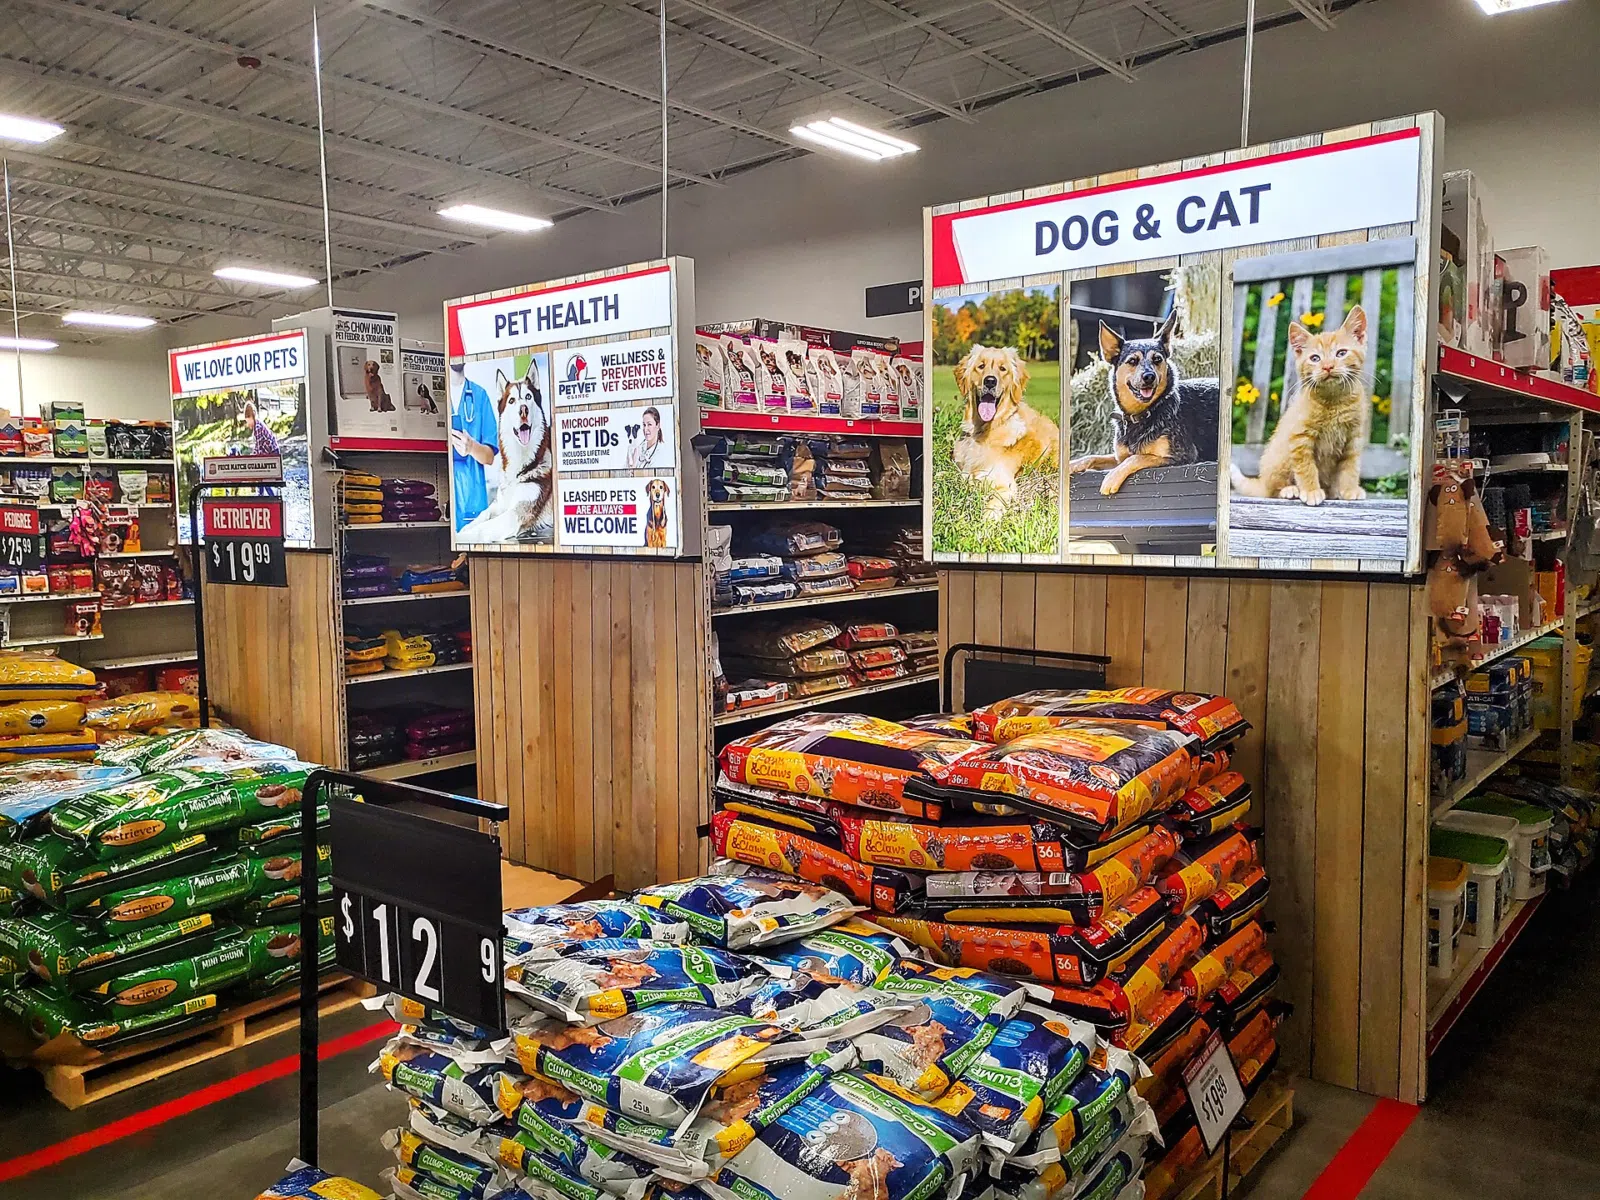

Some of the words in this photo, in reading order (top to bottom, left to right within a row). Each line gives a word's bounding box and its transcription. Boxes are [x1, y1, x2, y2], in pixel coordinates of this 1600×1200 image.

[1035, 209, 1119, 257] DOG
[1132, 203, 1161, 241] &
[1176, 183, 1272, 235] CAT
[908, 286, 923, 306] P
[494, 309, 532, 338] PET
[537, 293, 619, 332] HEALTH
[336, 332, 344, 340] PET
[350, 321, 371, 333] CHOW
[371, 323, 394, 336] HOUND
[184, 359, 202, 381] WE
[204, 355, 233, 378] LOVE
[235, 352, 261, 375] OUR
[264, 347, 297, 370] PETS
[413, 355, 428, 365] CHOW
[601, 349, 655, 367] WELLNESS
[657, 348, 665, 360] &
[602, 362, 666, 380] PREVENTIVE
[602, 380, 620, 392] VET
[622, 376, 667, 391] SERVICES
[561, 416, 609, 430] MICROCHIP
[562, 430, 591, 449] PET
[596, 429, 619, 449] IDs
[562, 450, 586, 458] INCLUDES
[587, 449, 610, 457] LIFETIME
[563, 491, 607, 502] LEASHED
[610, 489, 637, 502] PETS
[576, 505, 592, 514] ARE
[592, 504, 624, 514] ALWAYS
[4, 512, 32, 529] PEDIGREE
[213, 507, 271, 530] RETRIEVER
[564, 517, 638, 534] WELCOME
[982, 762, 1000, 770] SIZE
[871, 829, 898, 843] Paws
[201, 957, 218, 970] MINI
[219, 949, 245, 964] CHUNK
[481, 938, 496, 983] 9
